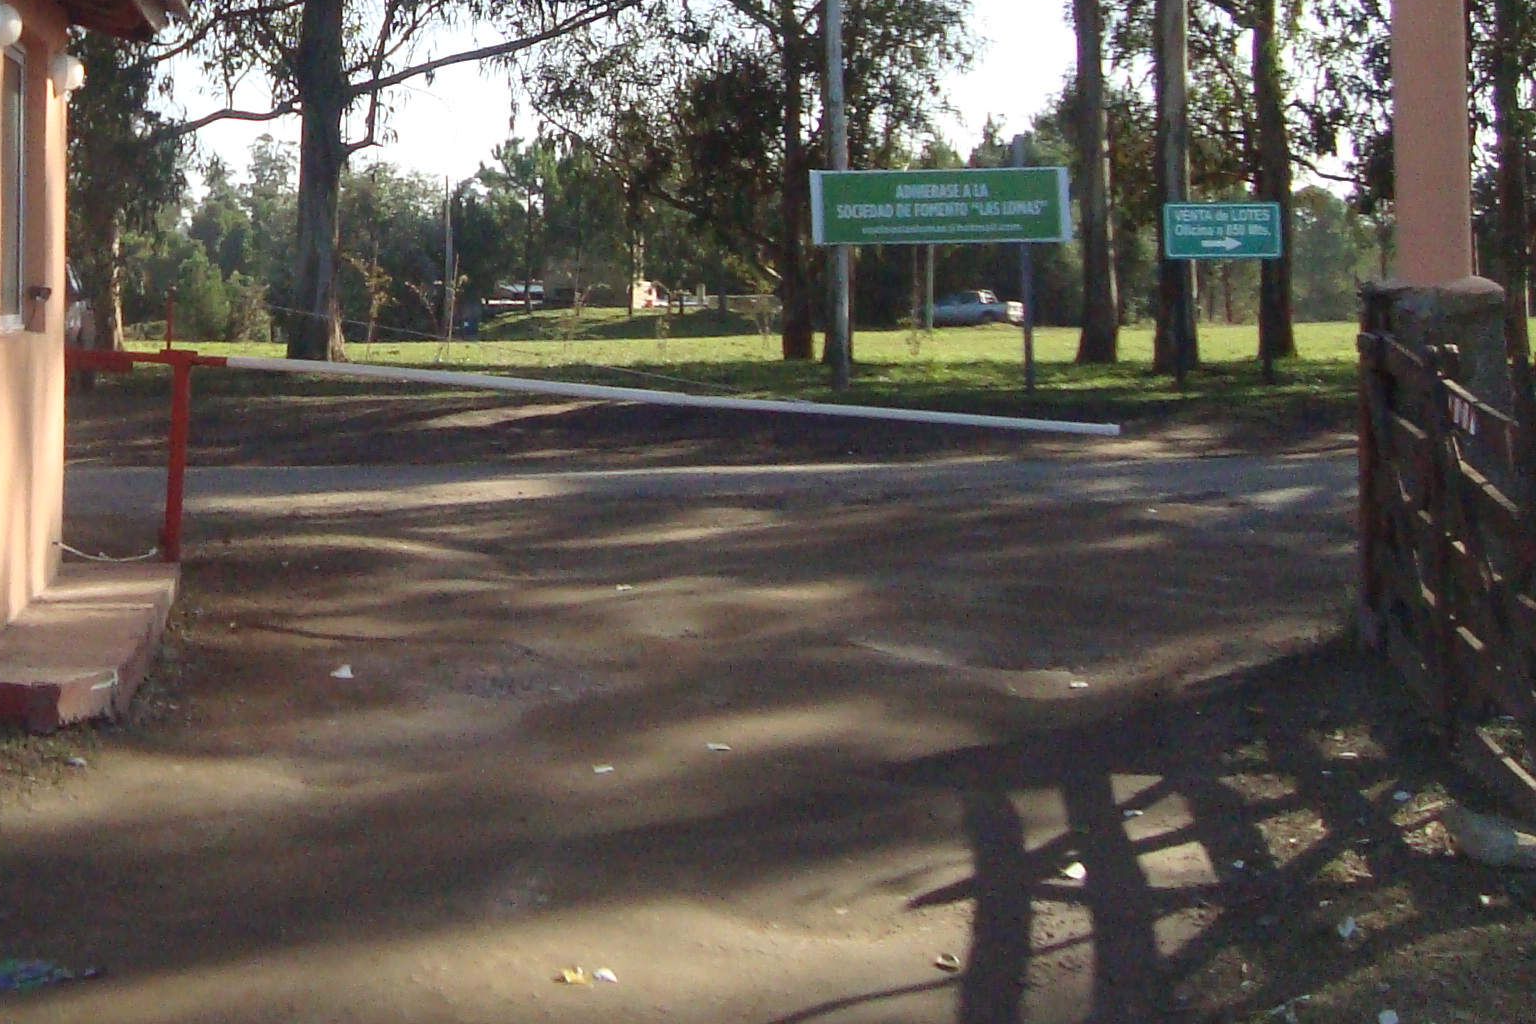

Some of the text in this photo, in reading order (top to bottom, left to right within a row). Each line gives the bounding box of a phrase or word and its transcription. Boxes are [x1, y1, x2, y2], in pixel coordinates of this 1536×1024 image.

[973, 184, 989, 198] LA
[837, 203, 893, 219] SOCIEDAD
[896, 203, 912, 218] DE
[914, 202, 968, 217] FOMENTO
[1175, 208, 1212, 222] VENTA
[1231, 208, 1271, 222] LOTES
